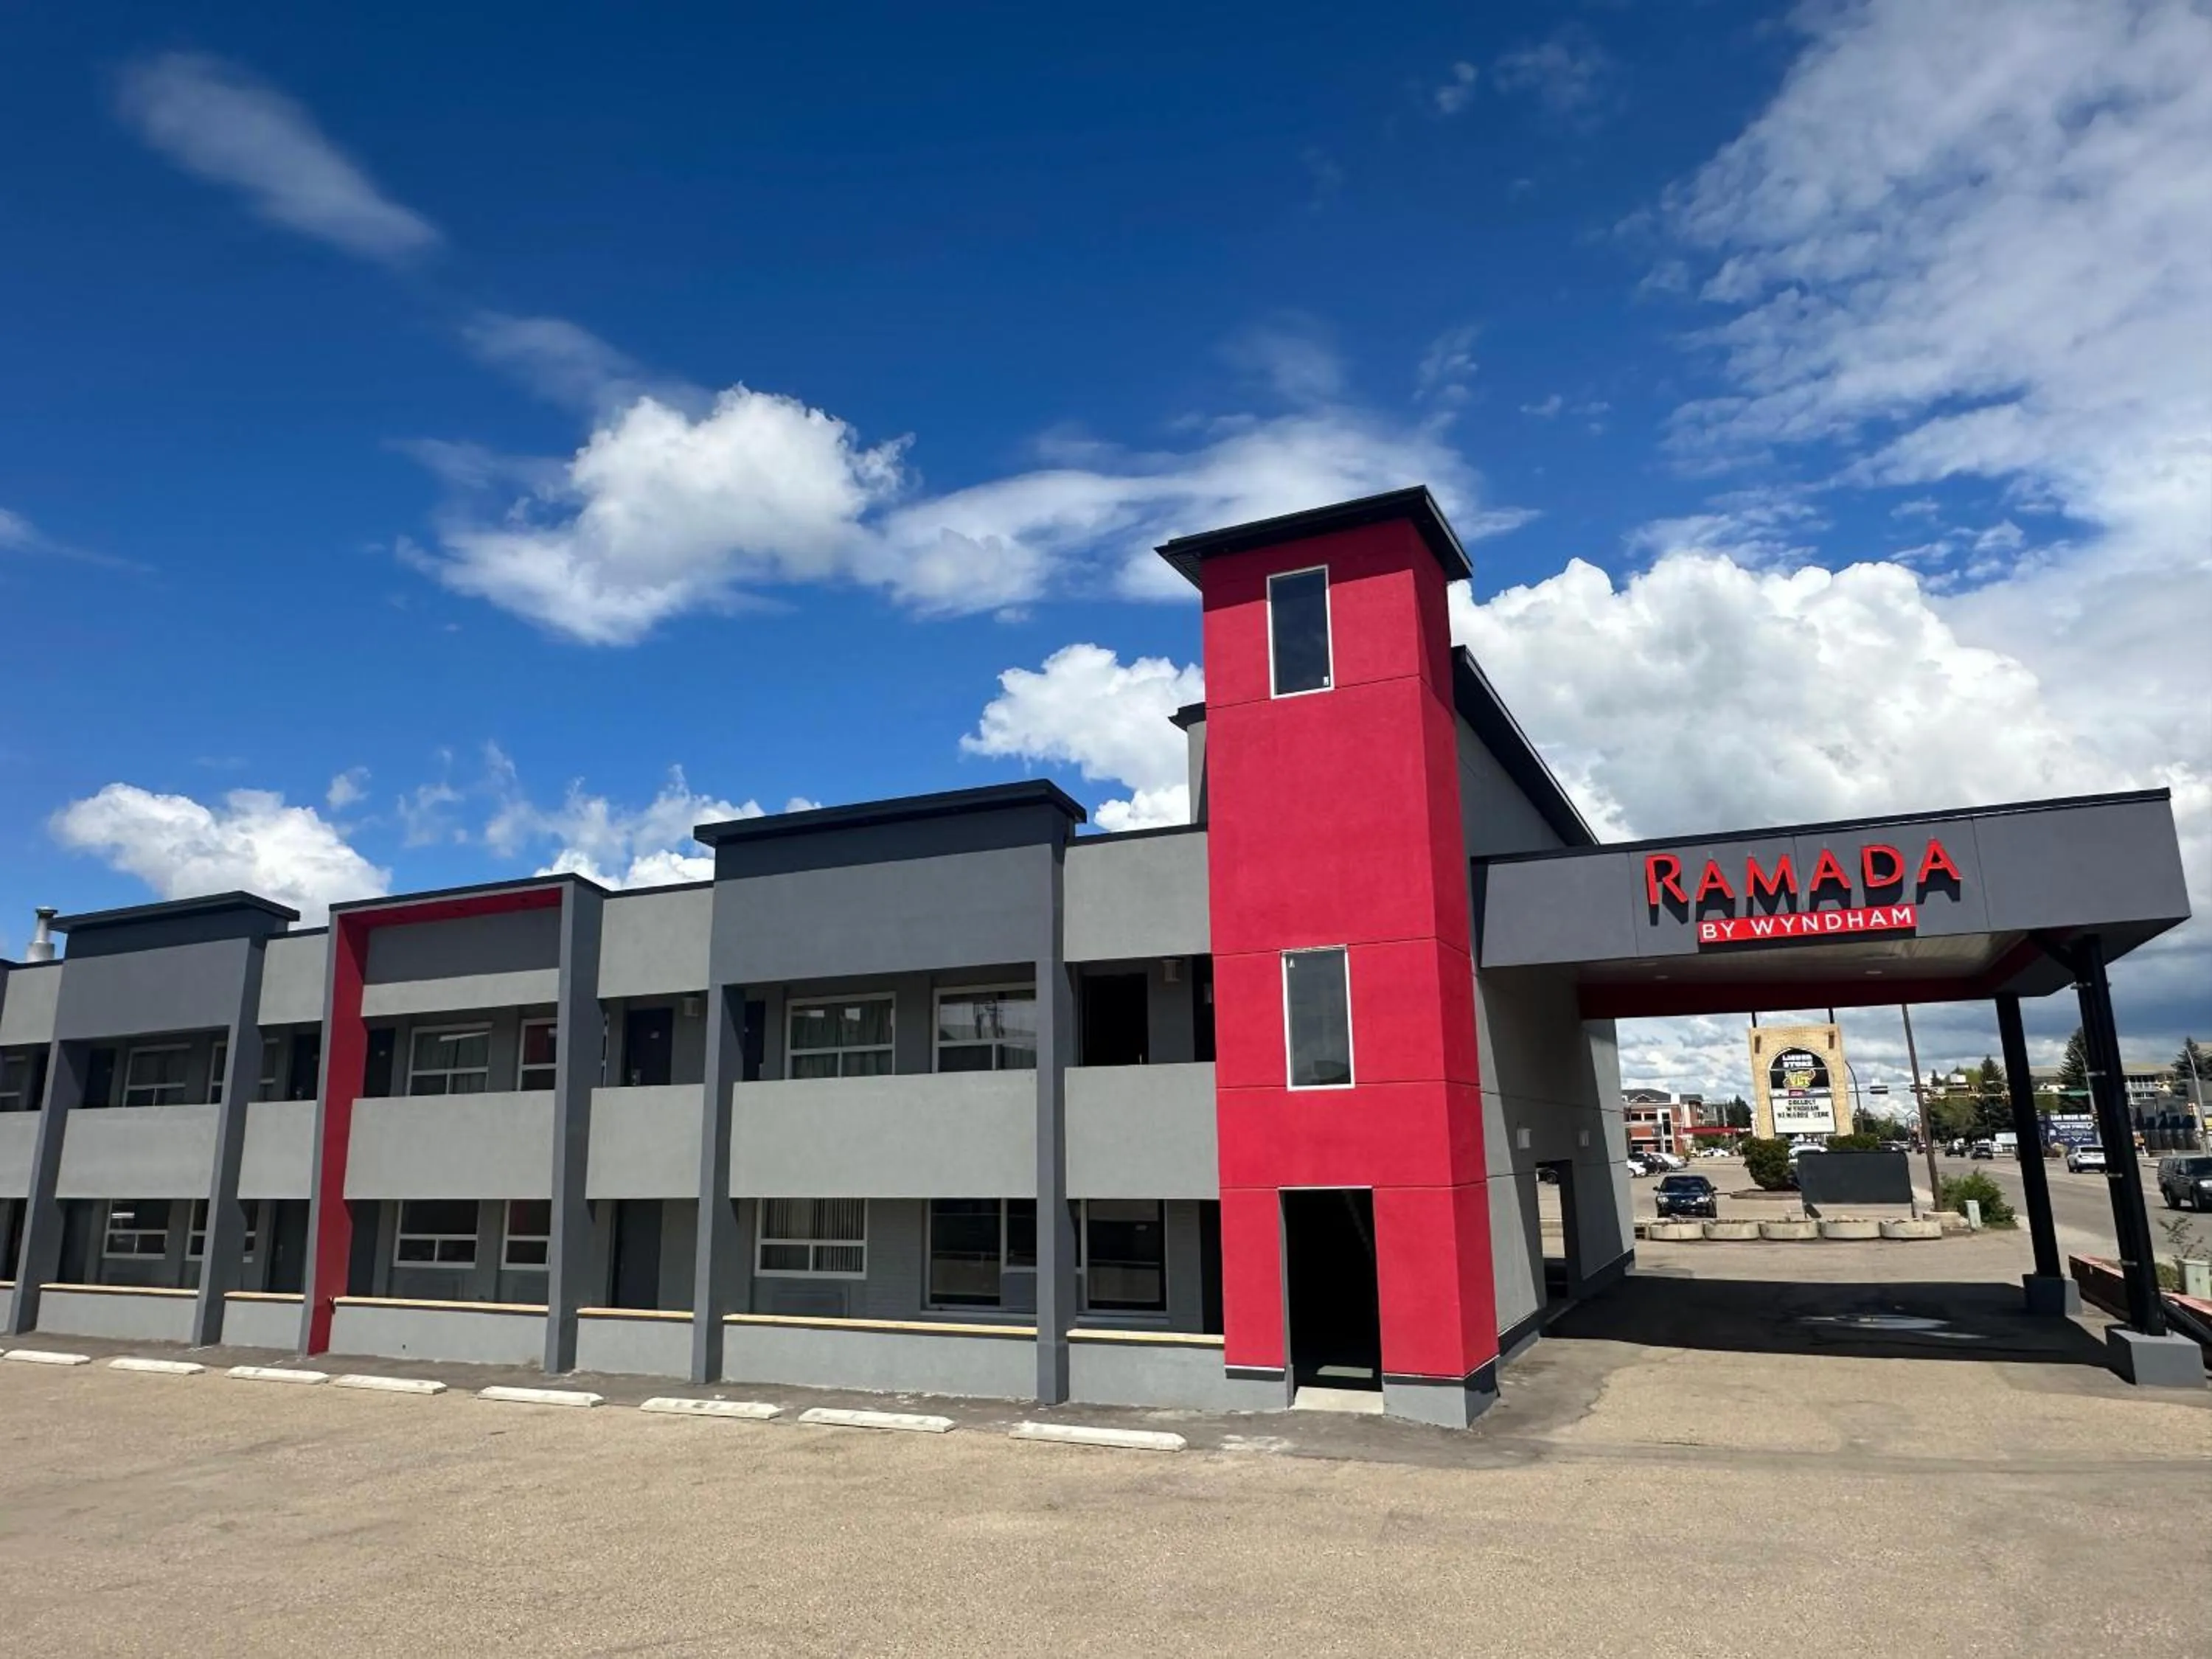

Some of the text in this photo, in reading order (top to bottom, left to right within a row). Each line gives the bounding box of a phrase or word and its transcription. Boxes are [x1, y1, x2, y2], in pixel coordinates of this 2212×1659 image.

[1644, 838, 1964, 905] RAMADA
[1702, 908, 1913, 940] BY WYNDHAM
